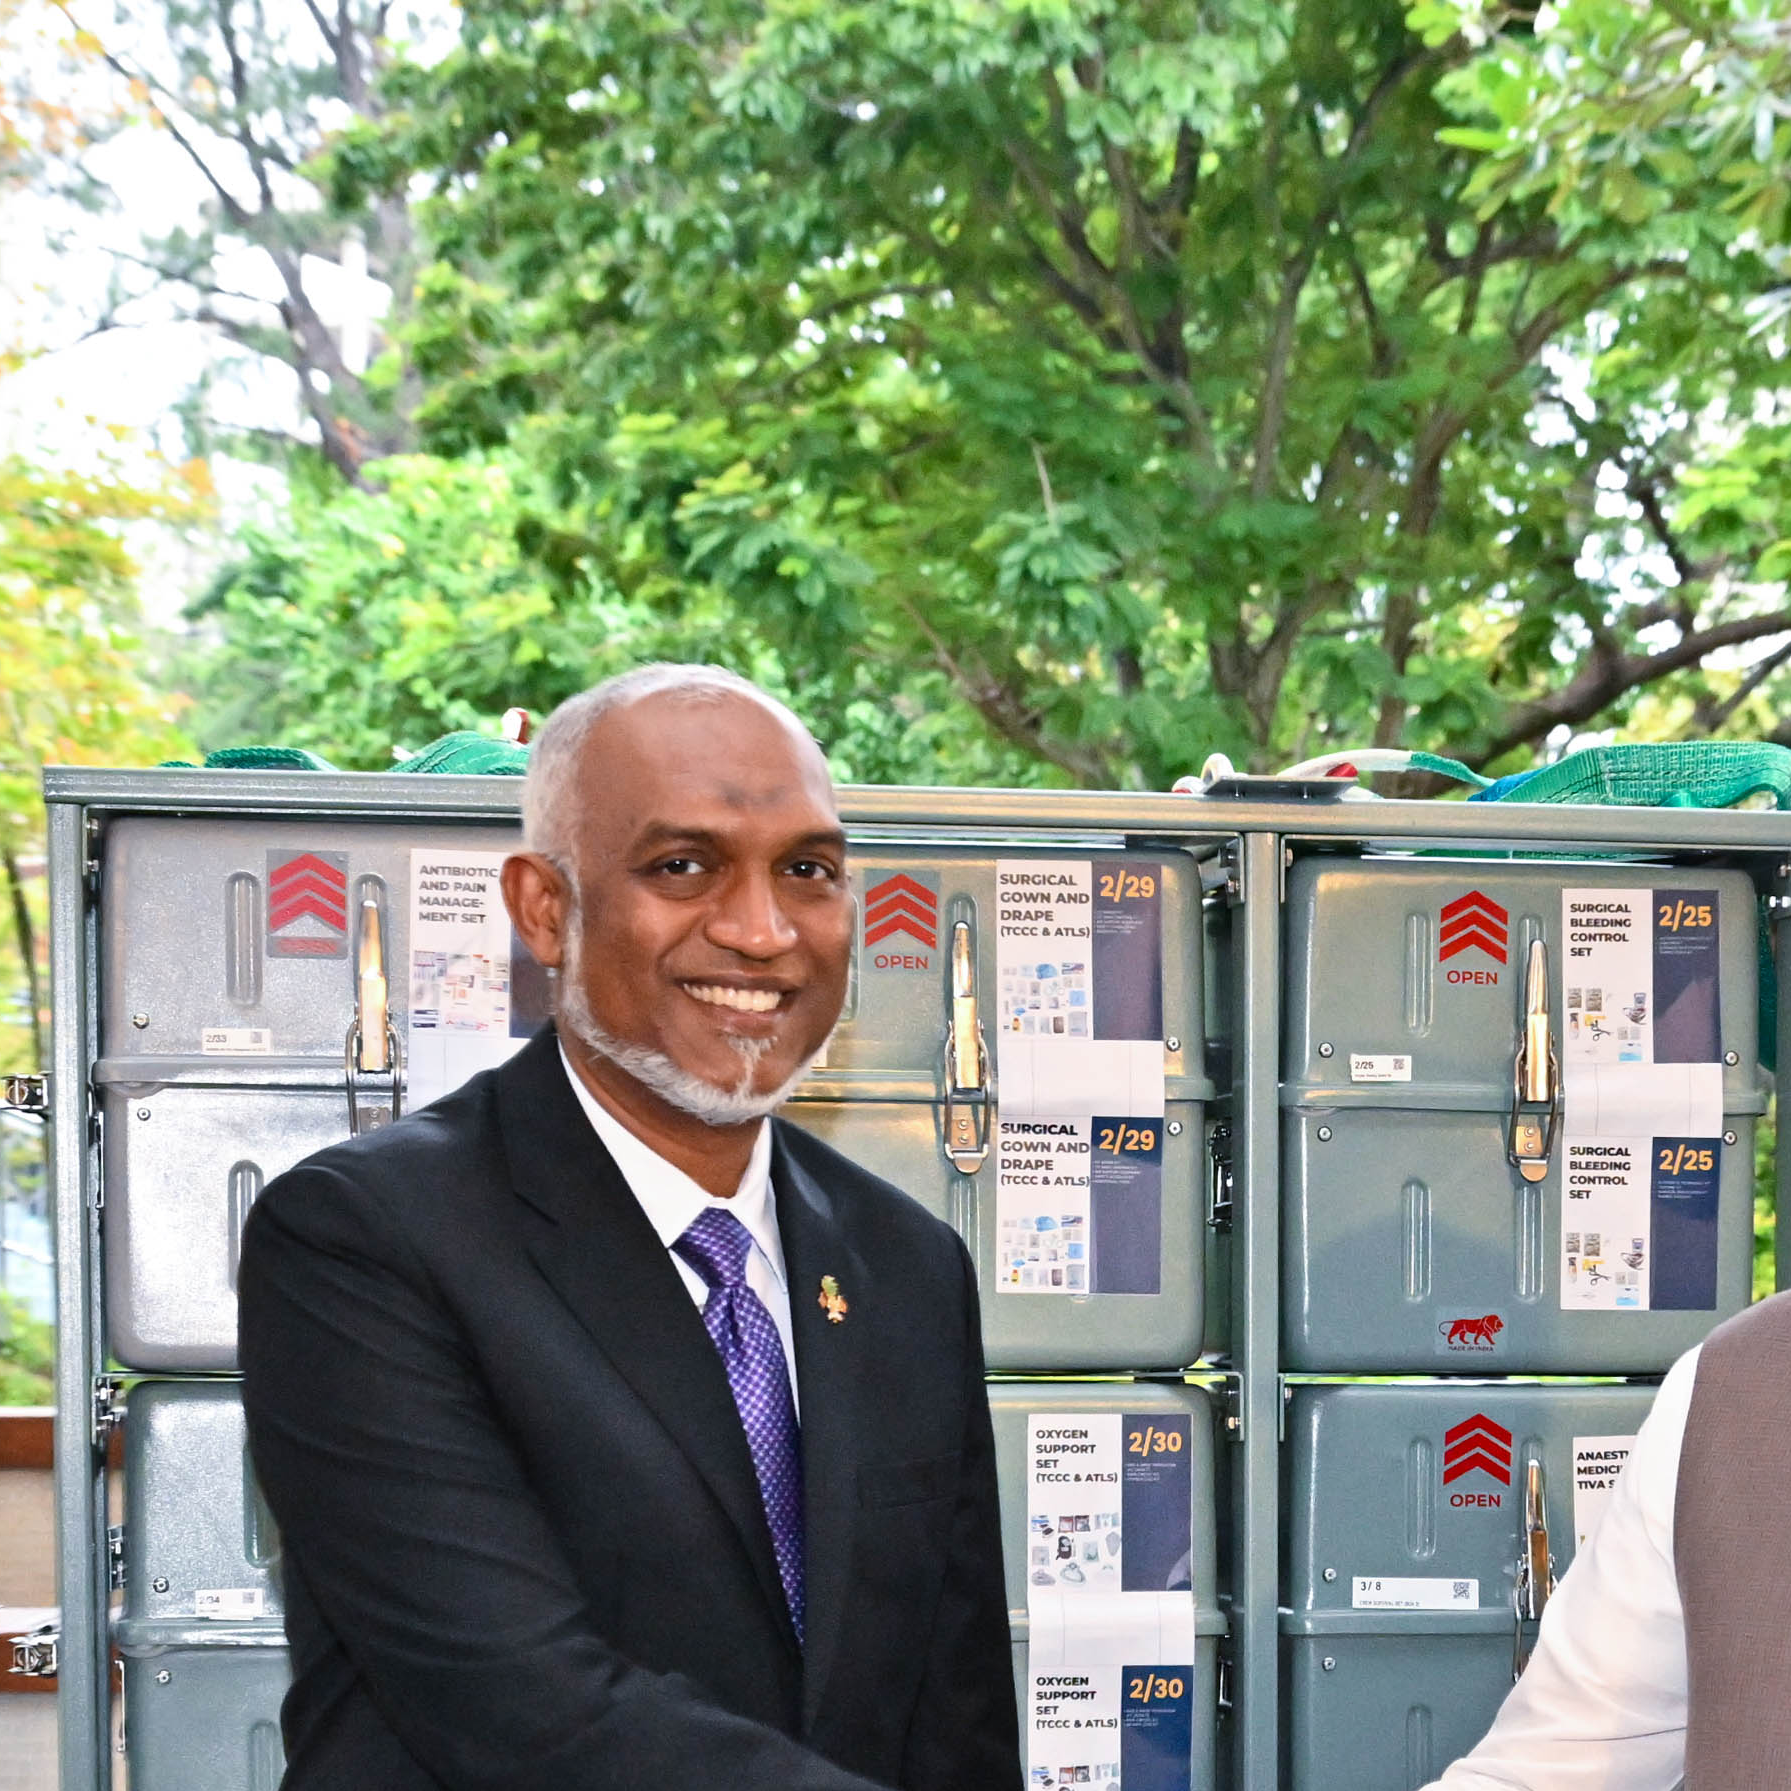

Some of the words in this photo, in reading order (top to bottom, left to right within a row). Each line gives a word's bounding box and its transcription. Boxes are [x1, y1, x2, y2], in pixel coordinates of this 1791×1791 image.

[420, 865, 498, 877] ANTIBIOTIC
[1000, 874, 1077, 886] SURGICAL
[419, 881, 449, 891] AND
[454, 883, 486, 892] PAIN
[1100, 870, 1155, 902] 2/29
[419, 897, 484, 907] MANAGE-
[1001, 892, 1051, 903] GOWN
[1055, 893, 1089, 904] AND
[1570, 903, 1632, 914] SURGICAL
[419, 912, 457, 922] MENT
[461, 914, 486, 923] SET
[1001, 910, 1054, 921] DRAPE
[1659, 901, 1713, 933] 2/25
[1570, 918, 1632, 928] BLEEDING
[1001, 926, 1038, 937] (TCCC
[1042, 927, 1050, 936] &
[1055, 927, 1090, 938] ATLS)
[1570, 932, 1629, 943] CONTROL
[1570, 947, 1593, 957] SET
[874, 955, 928, 970] OPEN
[1447, 970, 1497, 985] OPEN
[1001, 1123, 1078, 1136] SURGICAL
[1099, 1124, 1154, 1155] 2/29
[1001, 1141, 1051, 1152] GOWN
[1055, 1143, 1089, 1153] AND
[1569, 1146, 1632, 1157] SURGICAL
[1001, 1160, 1054, 1170] DRAPE
[1569, 1160, 1632, 1171] BLEEDING
[1658, 1144, 1713, 1177] 2/25
[1001, 1175, 1038, 1186] (TCCC
[1042, 1176, 1050, 1185] &
[1054, 1177, 1090, 1187] ATLS)
[1569, 1175, 1628, 1186] CONTROL
[1569, 1189, 1592, 1200] SET
[1035, 1430, 1088, 1440] OXYGEN
[1128, 1427, 1182, 1458] 2/30
[1035, 1444, 1096, 1455] SUPPORT
[1577, 1451, 1628, 1460] ANAEST
[1035, 1459, 1059, 1469] SET
[1577, 1465, 1622, 1475] MEDICI
[1035, 1472, 1069, 1485] (TCCC
[1073, 1473, 1082, 1483] &
[1085, 1472, 1118, 1485] ATLS)
[1578, 1481, 1605, 1489] TIVA
[1450, 1494, 1501, 1508] OPEN
[1035, 1676, 1089, 1687] OXYGEN
[1129, 1674, 1183, 1705] 2/30
[1035, 1690, 1096, 1701] SUPPORT
[1035, 1705, 1059, 1716] SET
[1035, 1718, 1069, 1731] (TCCC
[1073, 1719, 1082, 1729] &
[1085, 1718, 1118, 1731] ATLS)
